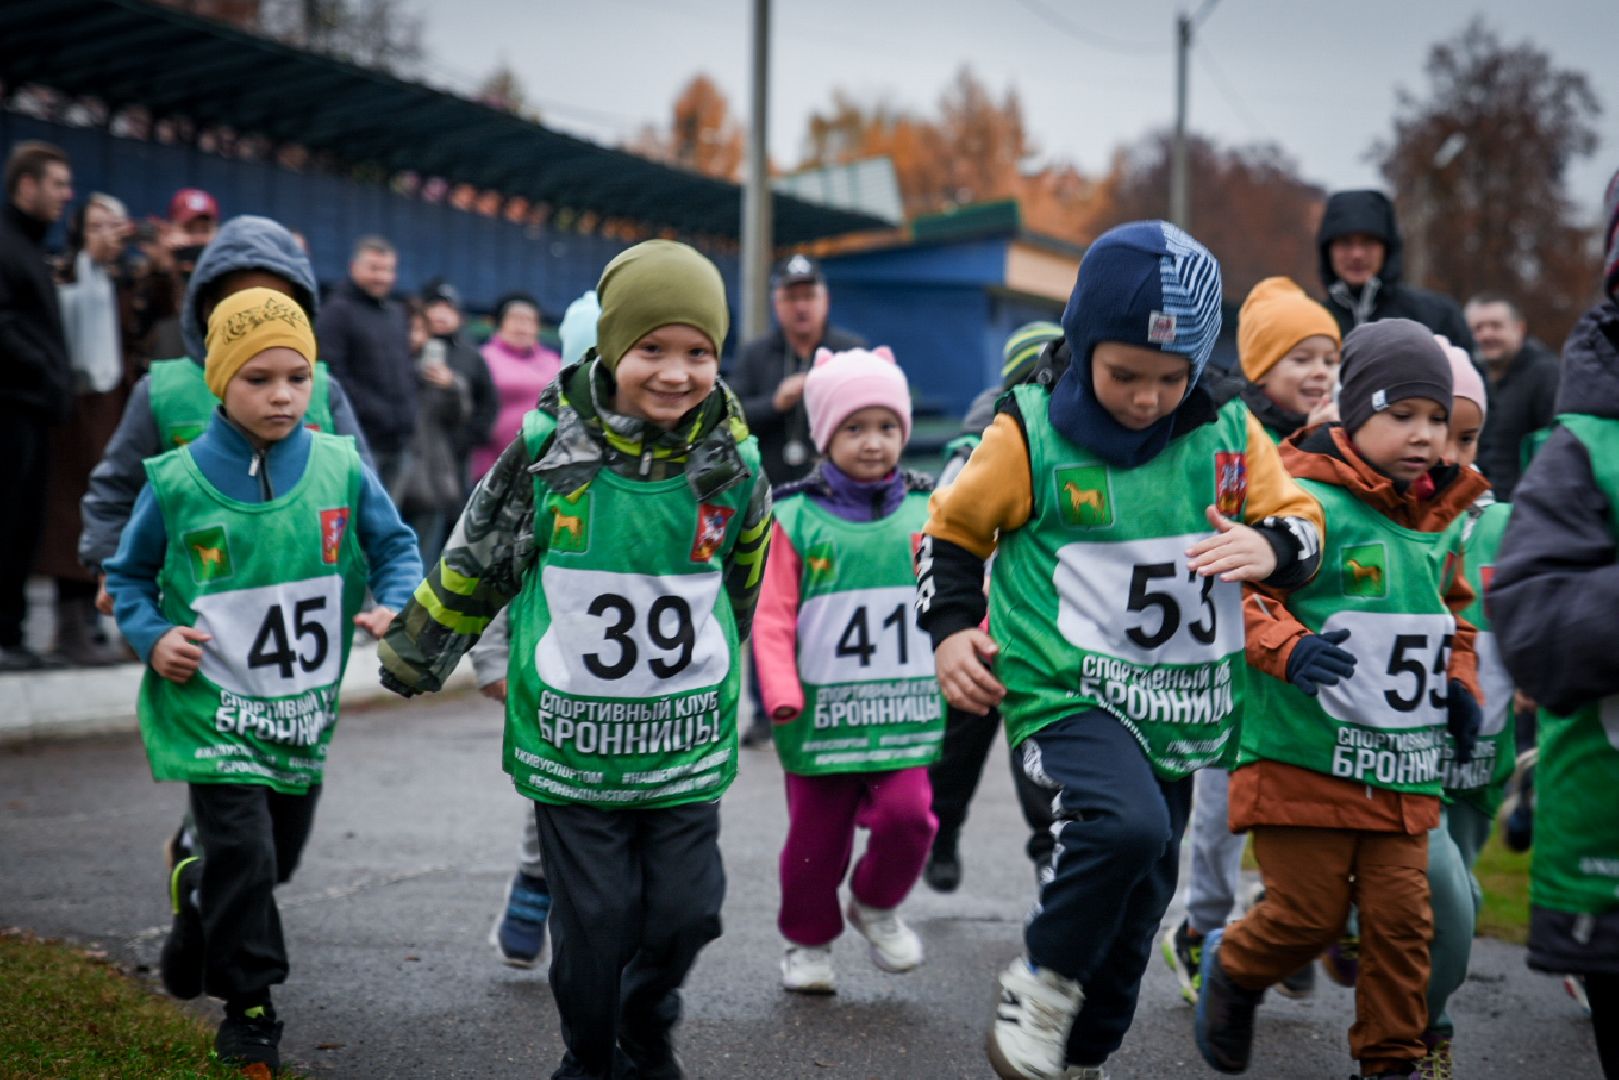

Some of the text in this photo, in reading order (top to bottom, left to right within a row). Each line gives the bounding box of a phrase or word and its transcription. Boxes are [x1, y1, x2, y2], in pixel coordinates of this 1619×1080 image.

[247, 596, 328, 678] 45
[583, 593, 695, 680] 39
[836, 603, 910, 668] 41
[1126, 562, 1216, 650] 53
[538, 709, 720, 754] БРОННИЦЫ
[540, 690, 718, 722] СПОРТИВНЫЙ КЛУБ
[815, 695, 941, 729] БРОННИЦЫ
